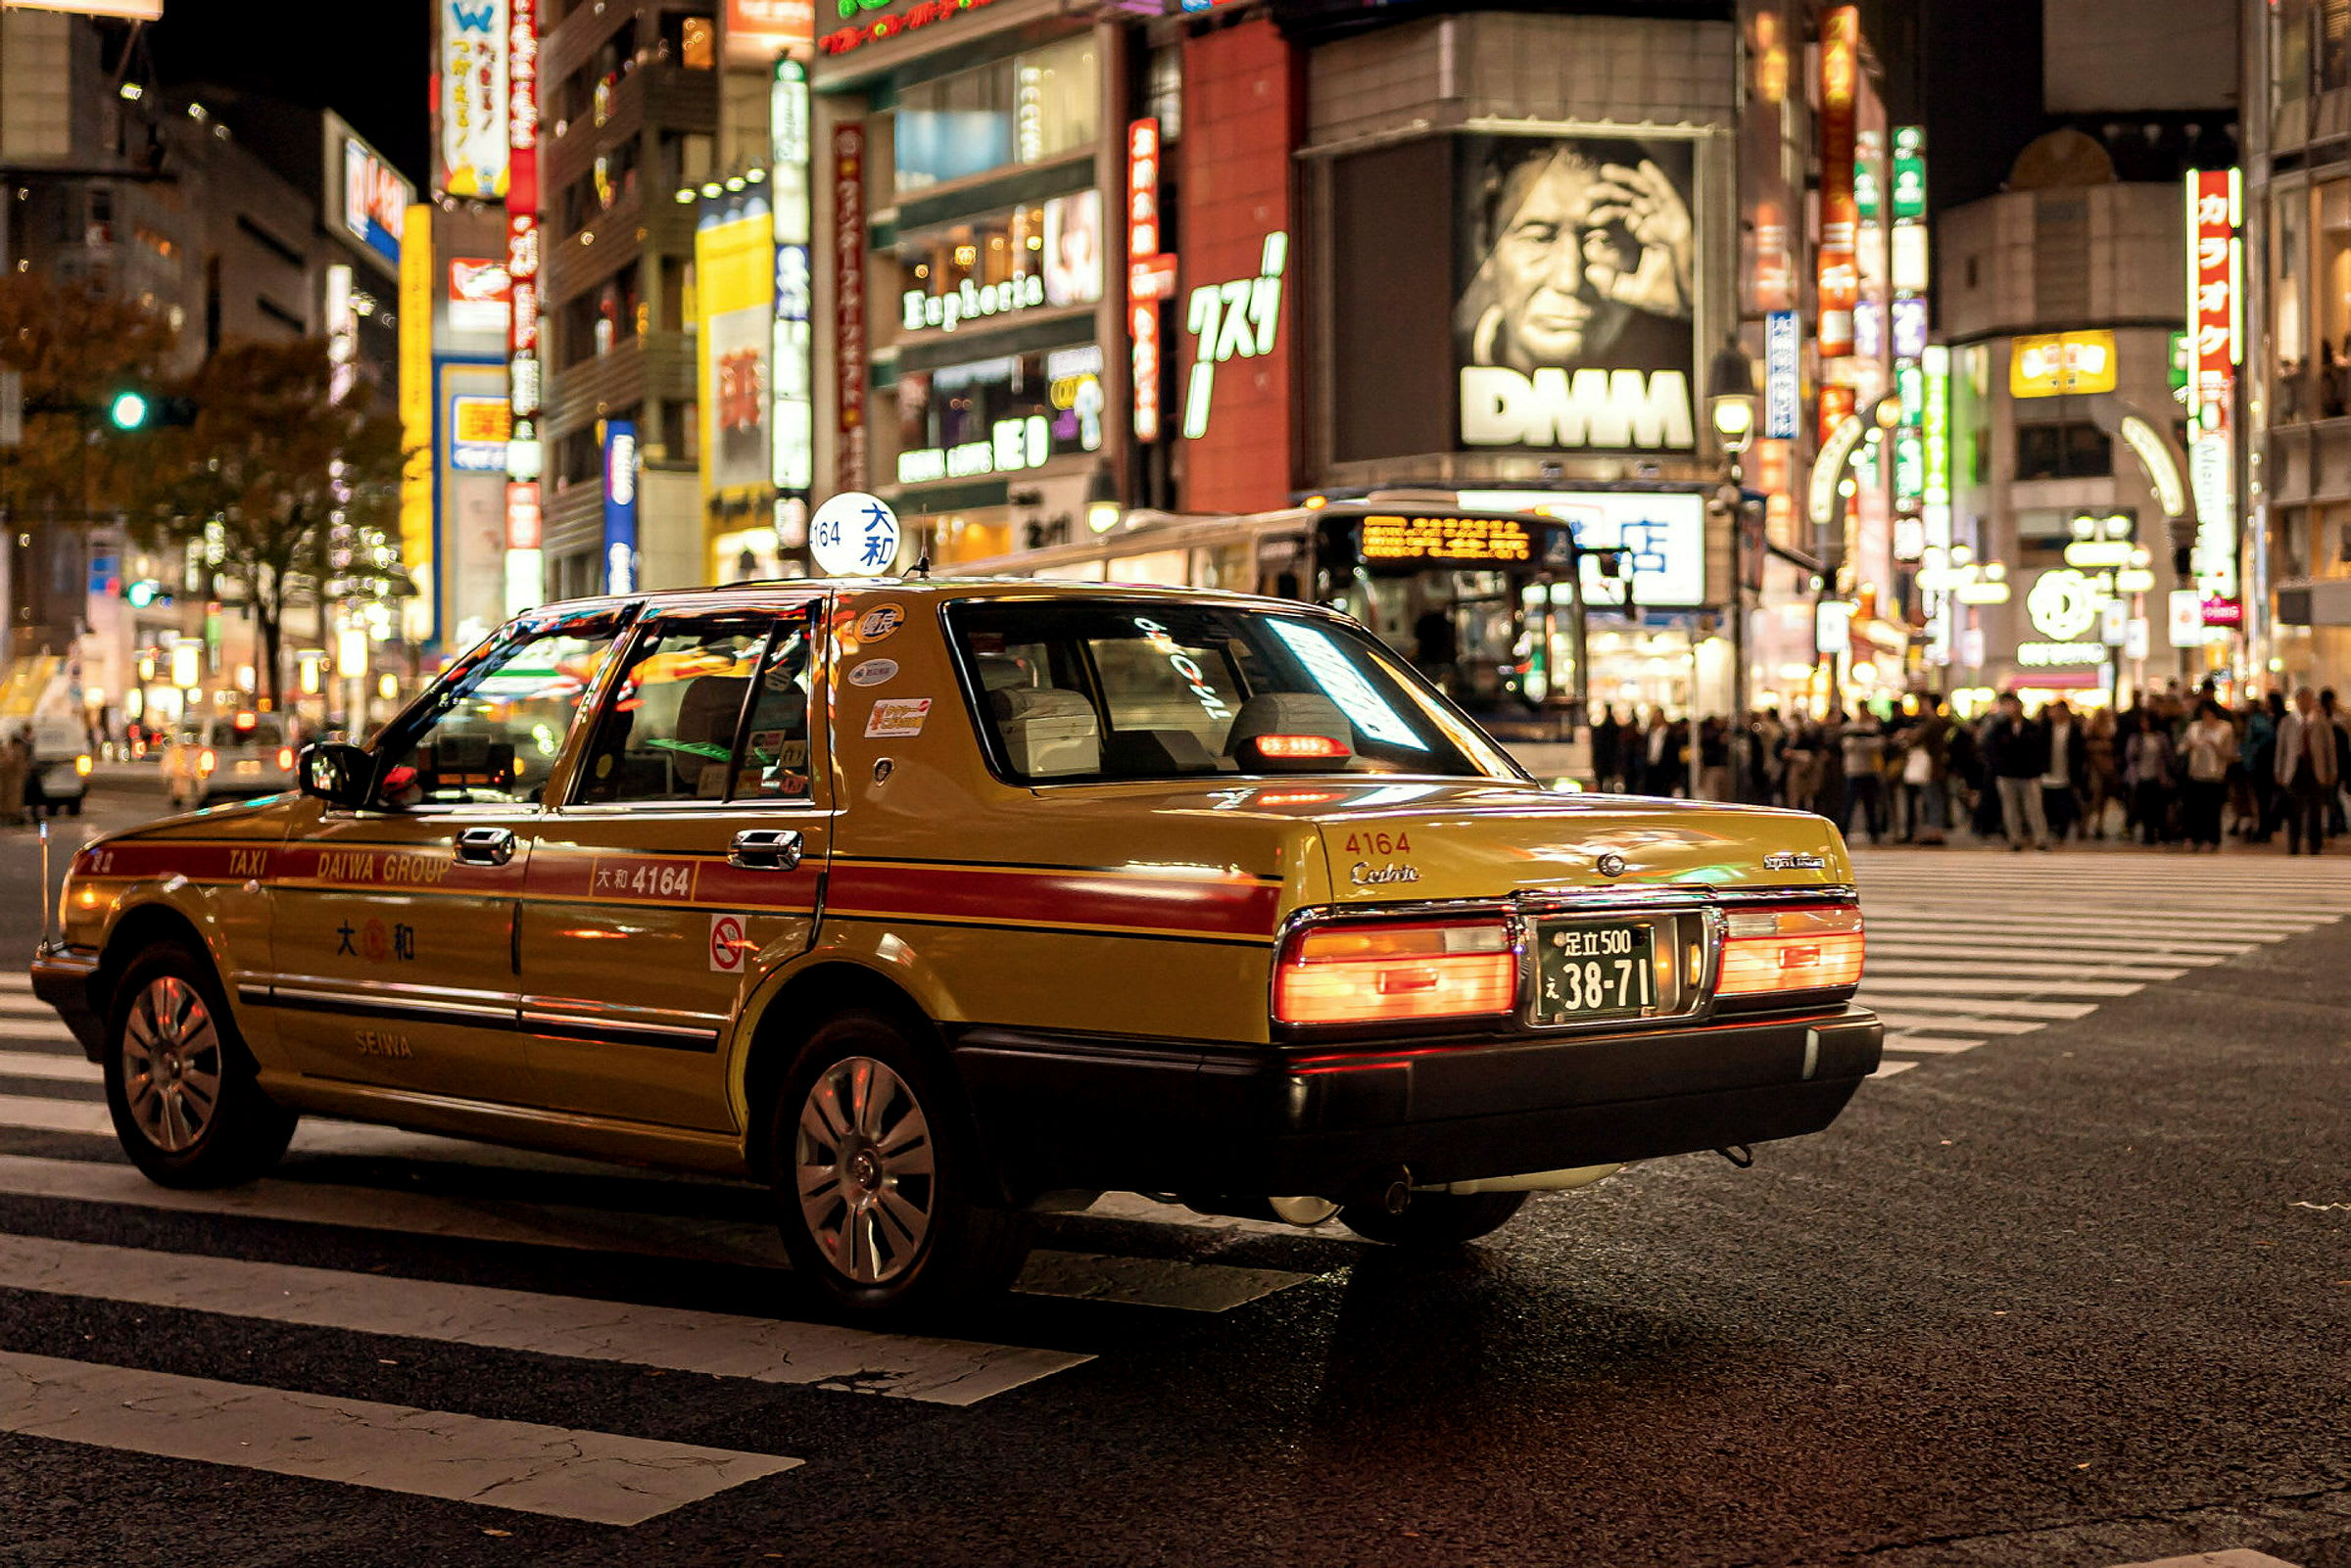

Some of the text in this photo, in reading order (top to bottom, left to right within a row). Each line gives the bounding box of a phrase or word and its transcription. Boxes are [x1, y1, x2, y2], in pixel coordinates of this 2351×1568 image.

[2198, 194, 2230, 355] カラオケ
[903, 274, 1043, 332] Euphoria
[860, 502, 893, 566] 大和
[1346, 832, 1411, 855] 4164
[229, 849, 268, 877] TAXI
[316, 852, 451, 882] DAIWA GROUP
[597, 866, 689, 895] 大和 4164
[1546, 959, 1649, 1011] え 38-71
[355, 1030, 412, 1059] SEIWA
